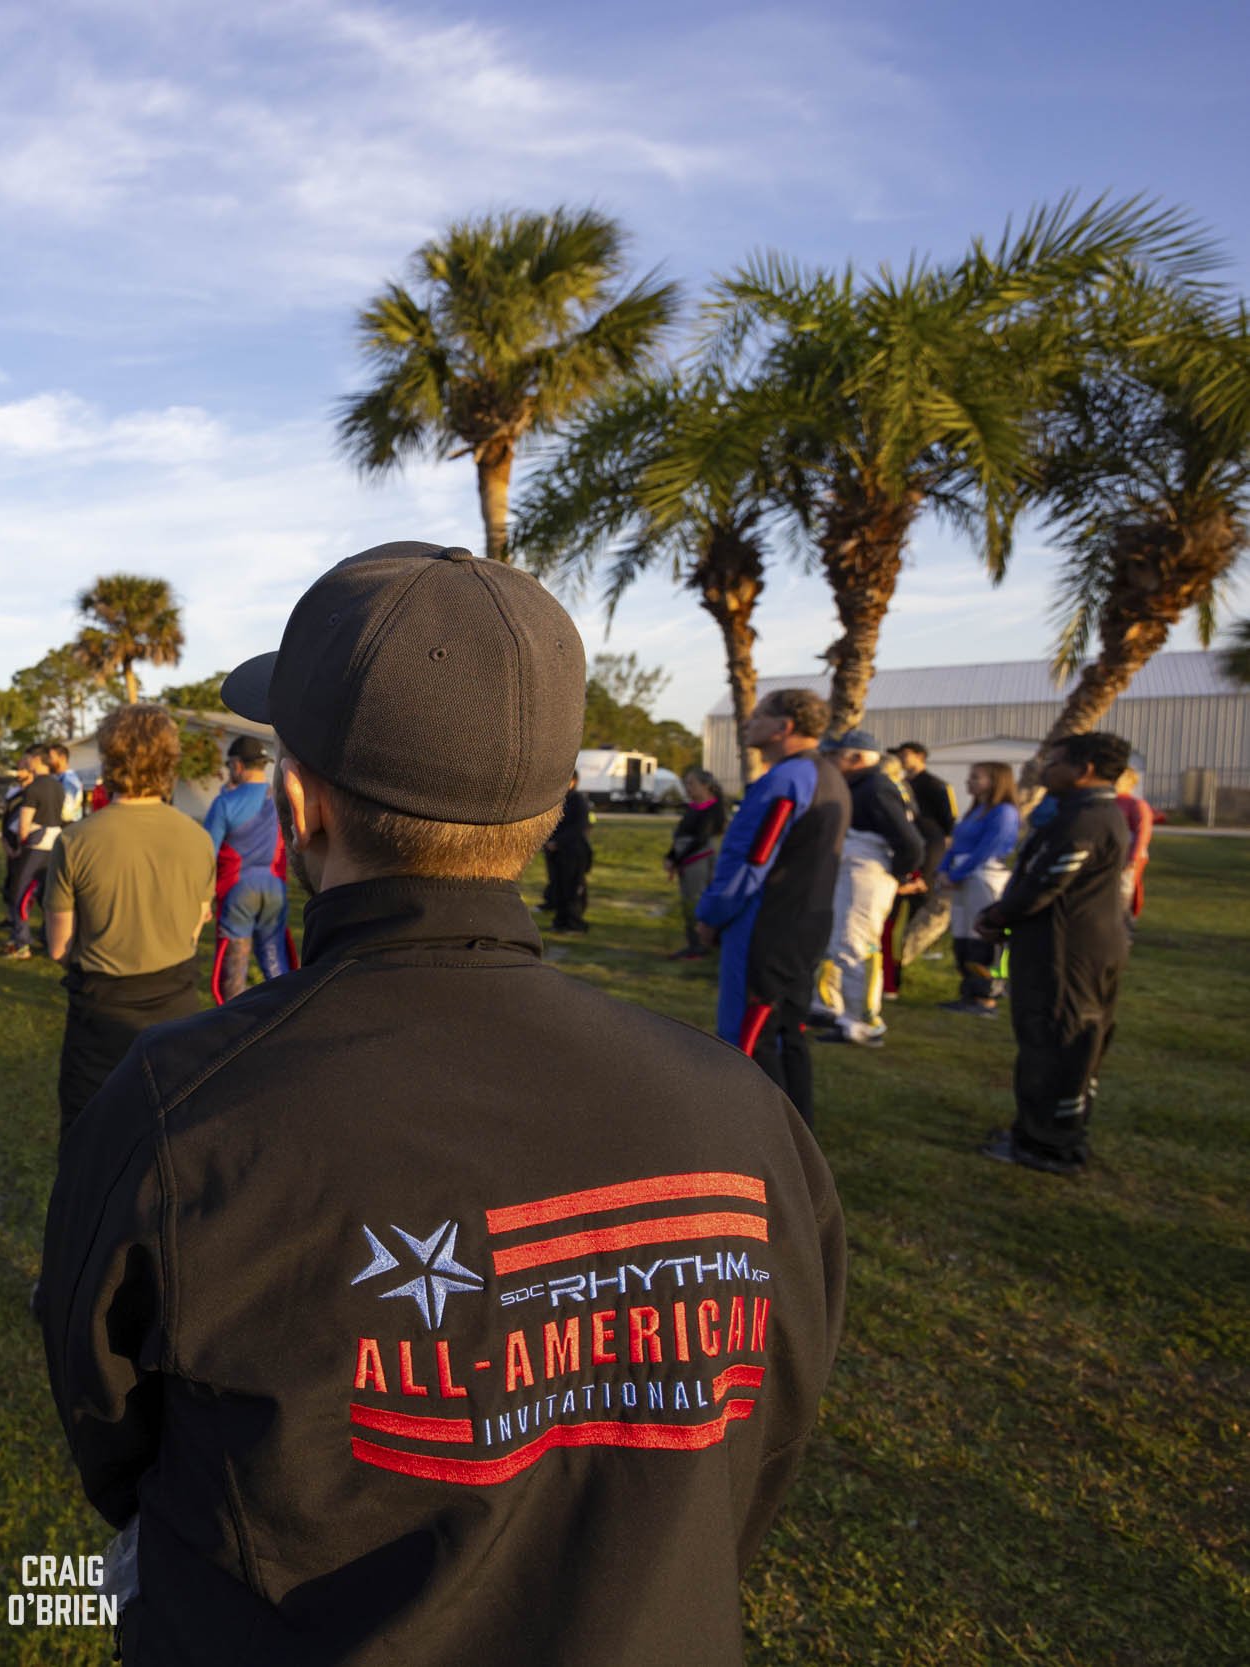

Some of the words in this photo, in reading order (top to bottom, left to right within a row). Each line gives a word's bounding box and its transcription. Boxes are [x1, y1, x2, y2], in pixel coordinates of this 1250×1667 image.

[500, 1283, 544, 1306] SDC
[548, 1251, 750, 1307] RHYTHM
[751, 1270, 770, 1282] XP
[355, 1295, 771, 1399] ALL-AMERICAN
[484, 1380, 709, 1446] INVITATIONAL
